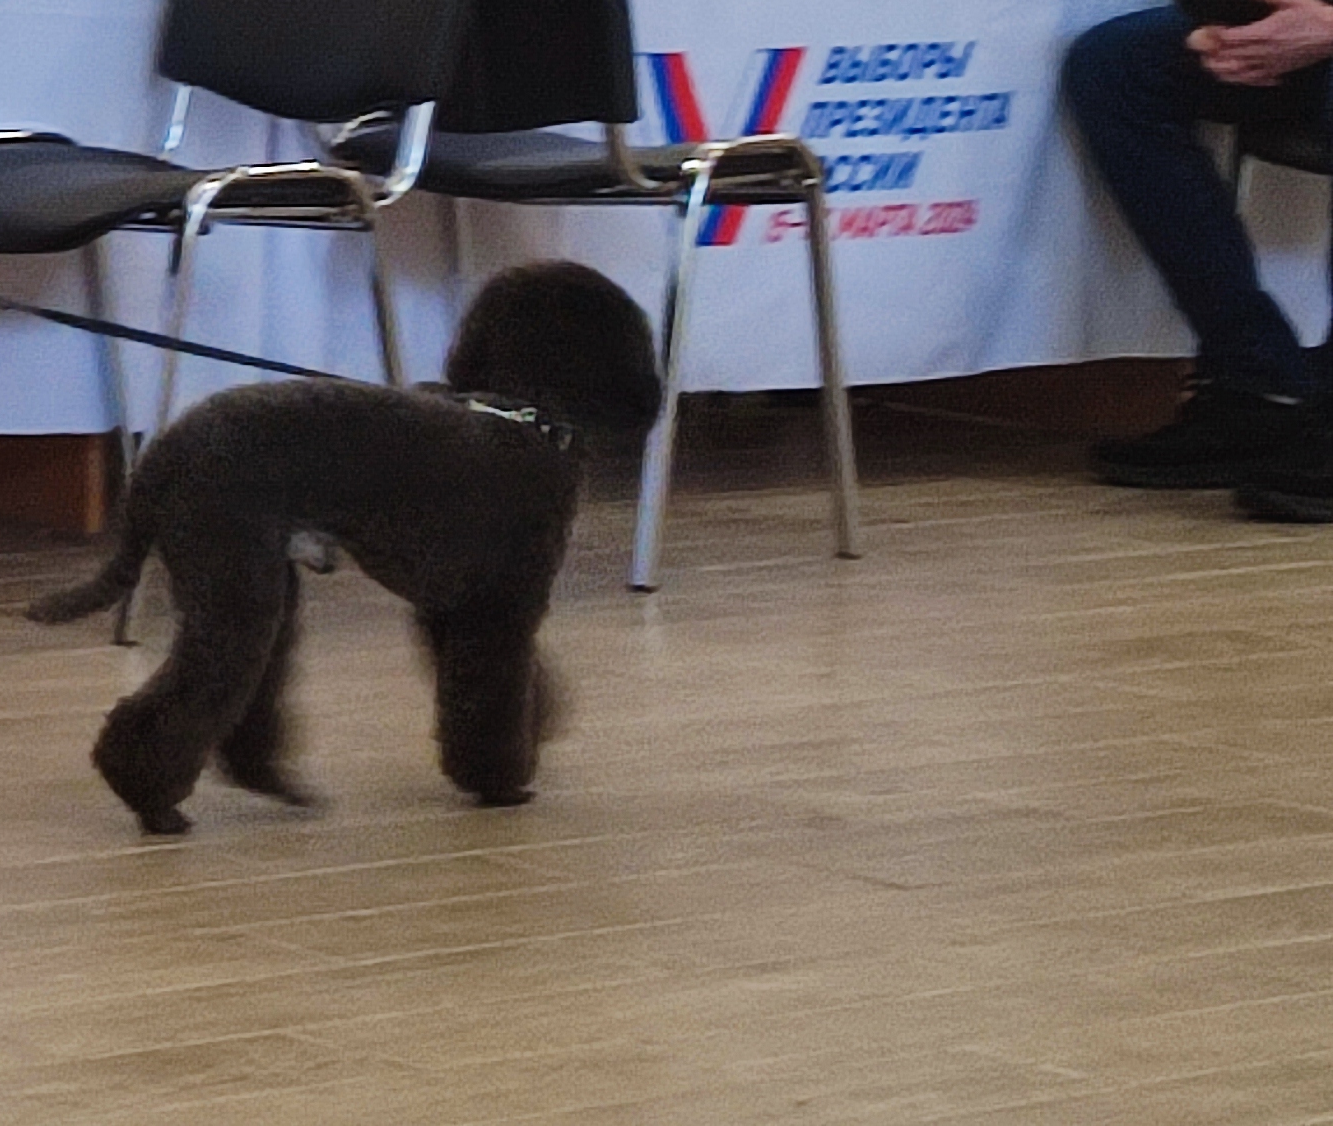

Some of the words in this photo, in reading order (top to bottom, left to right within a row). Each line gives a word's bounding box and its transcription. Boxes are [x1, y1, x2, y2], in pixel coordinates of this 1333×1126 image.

[817, 40, 978, 85] ВЫБОРЫ
[800, 91, 1016, 141] ПРЕЗИДЕНТА
[820, 151, 925, 194] ССИИ
